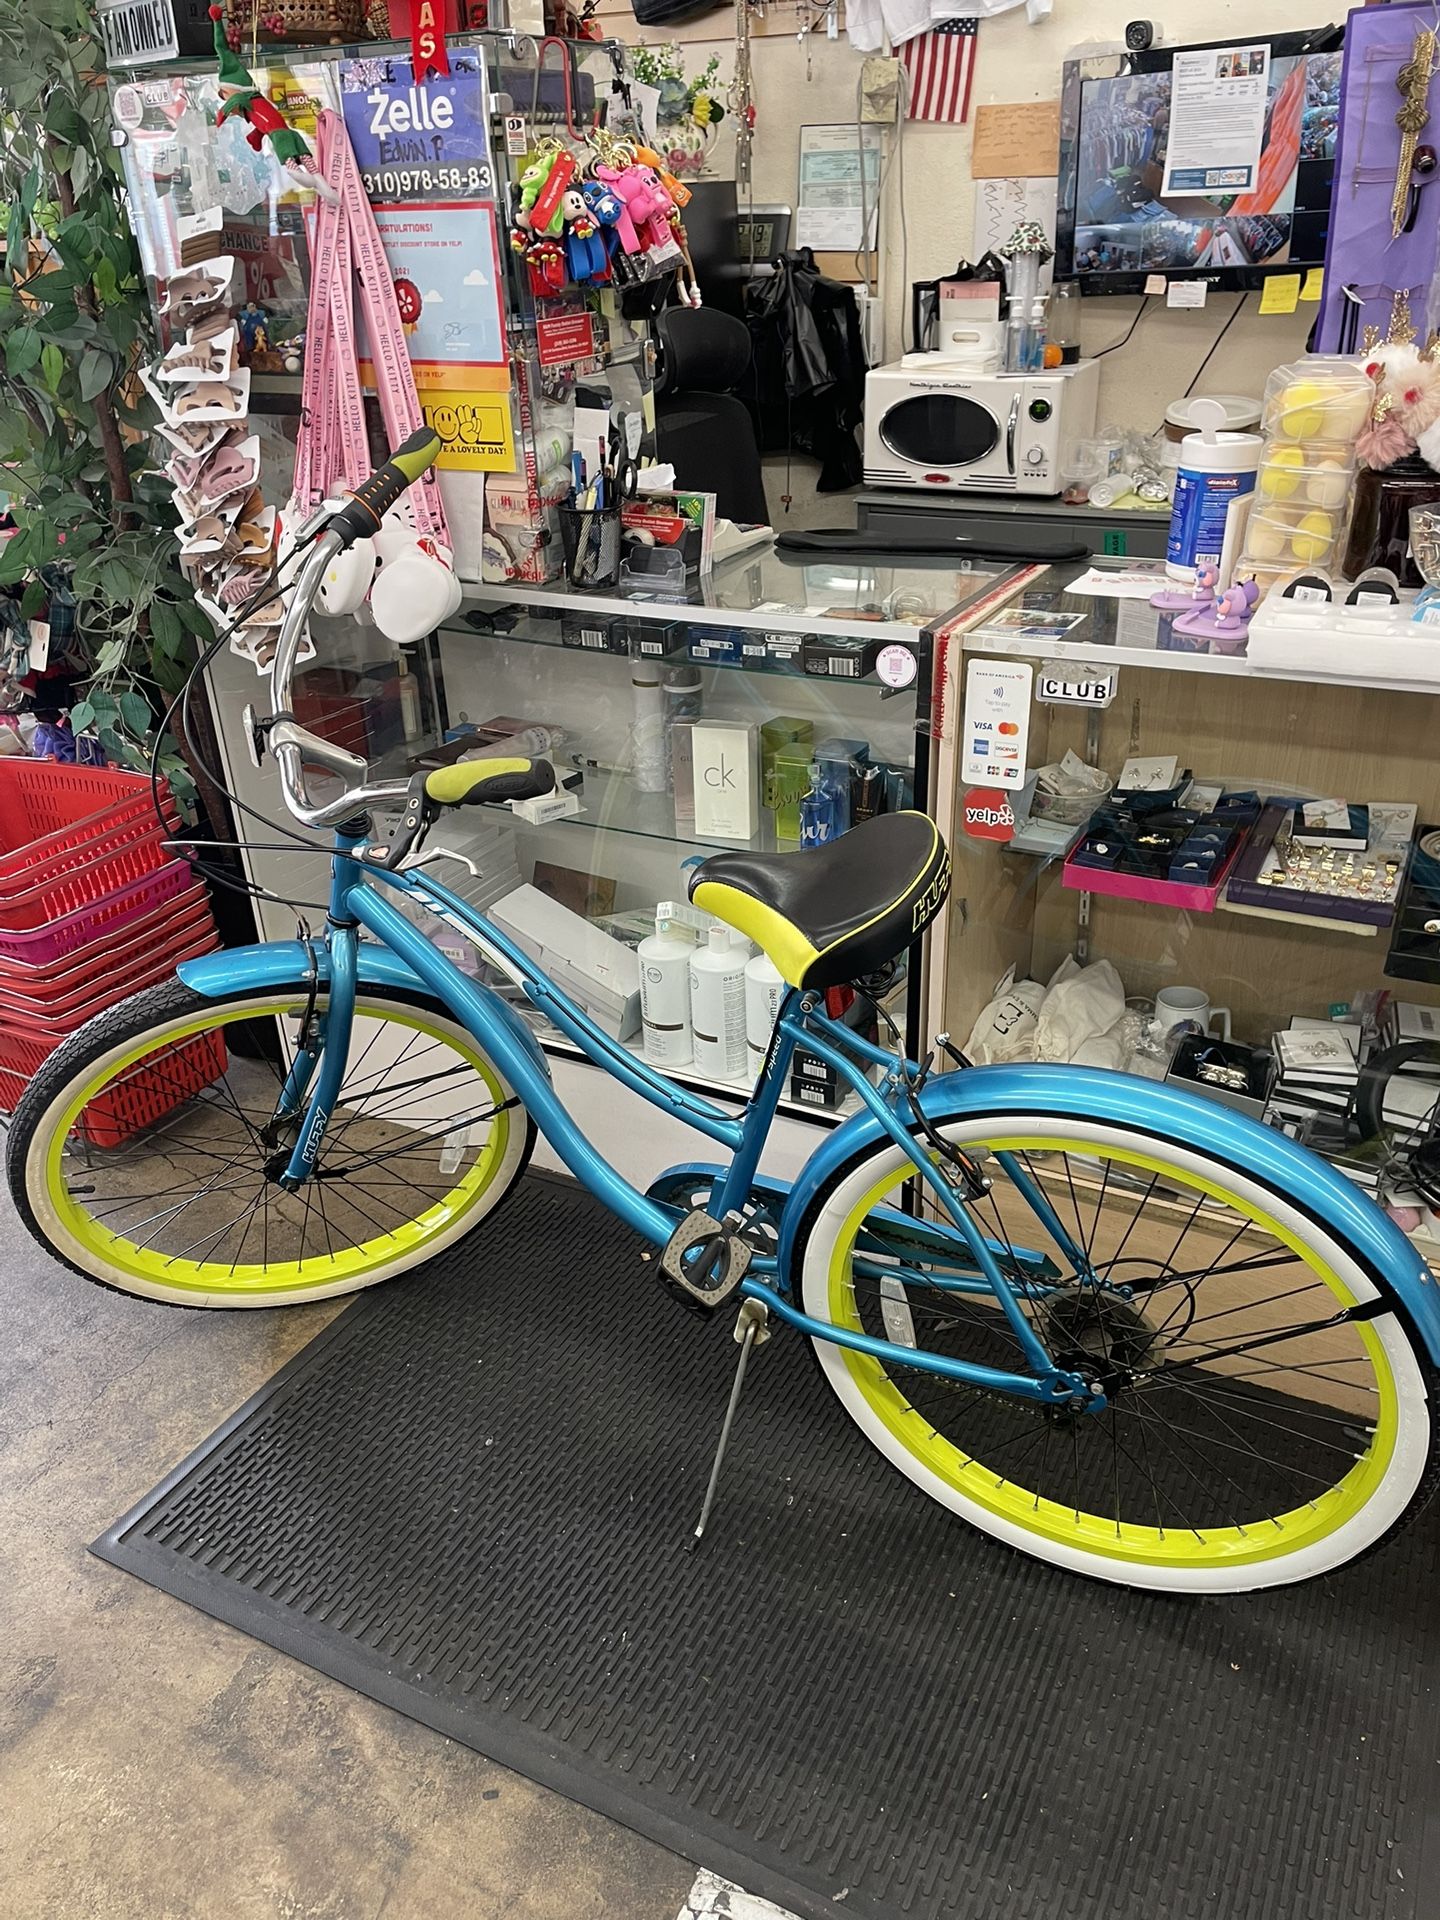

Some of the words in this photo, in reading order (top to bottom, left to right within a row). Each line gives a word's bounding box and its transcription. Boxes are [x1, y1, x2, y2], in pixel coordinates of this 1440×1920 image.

[367, 87, 454, 140] Zelle
[331, 152, 343, 181] HELLO
[347, 184, 361, 214] KITTY
[423, 240, 440, 248] STORE
[320, 246, 332, 274] HELLO
[360, 243, 374, 271] HELLO
[367, 276, 380, 305] KITTY
[317, 279, 329, 309] KITTY
[331, 281, 344, 310] KITTY
[381, 270, 393, 300] HELLO
[335, 315, 349, 342] HELLO
[313, 336, 324, 366] HELLO
[379, 334, 393, 362] HELLO
[386, 366, 400, 394] KITTY
[312, 369, 321, 397] KITTY
[345, 370, 358, 400] KITTY
[351, 404, 362, 432] HELLO
[457, 446, 487, 454] LOVELY
[488, 446, 507, 455] DAY!
[1045, 680, 1107, 700] CLUB
[973, 721, 993, 731] VISA
[967, 808, 999, 825] yelp
[301, 1105, 328, 1164] HUFFY
